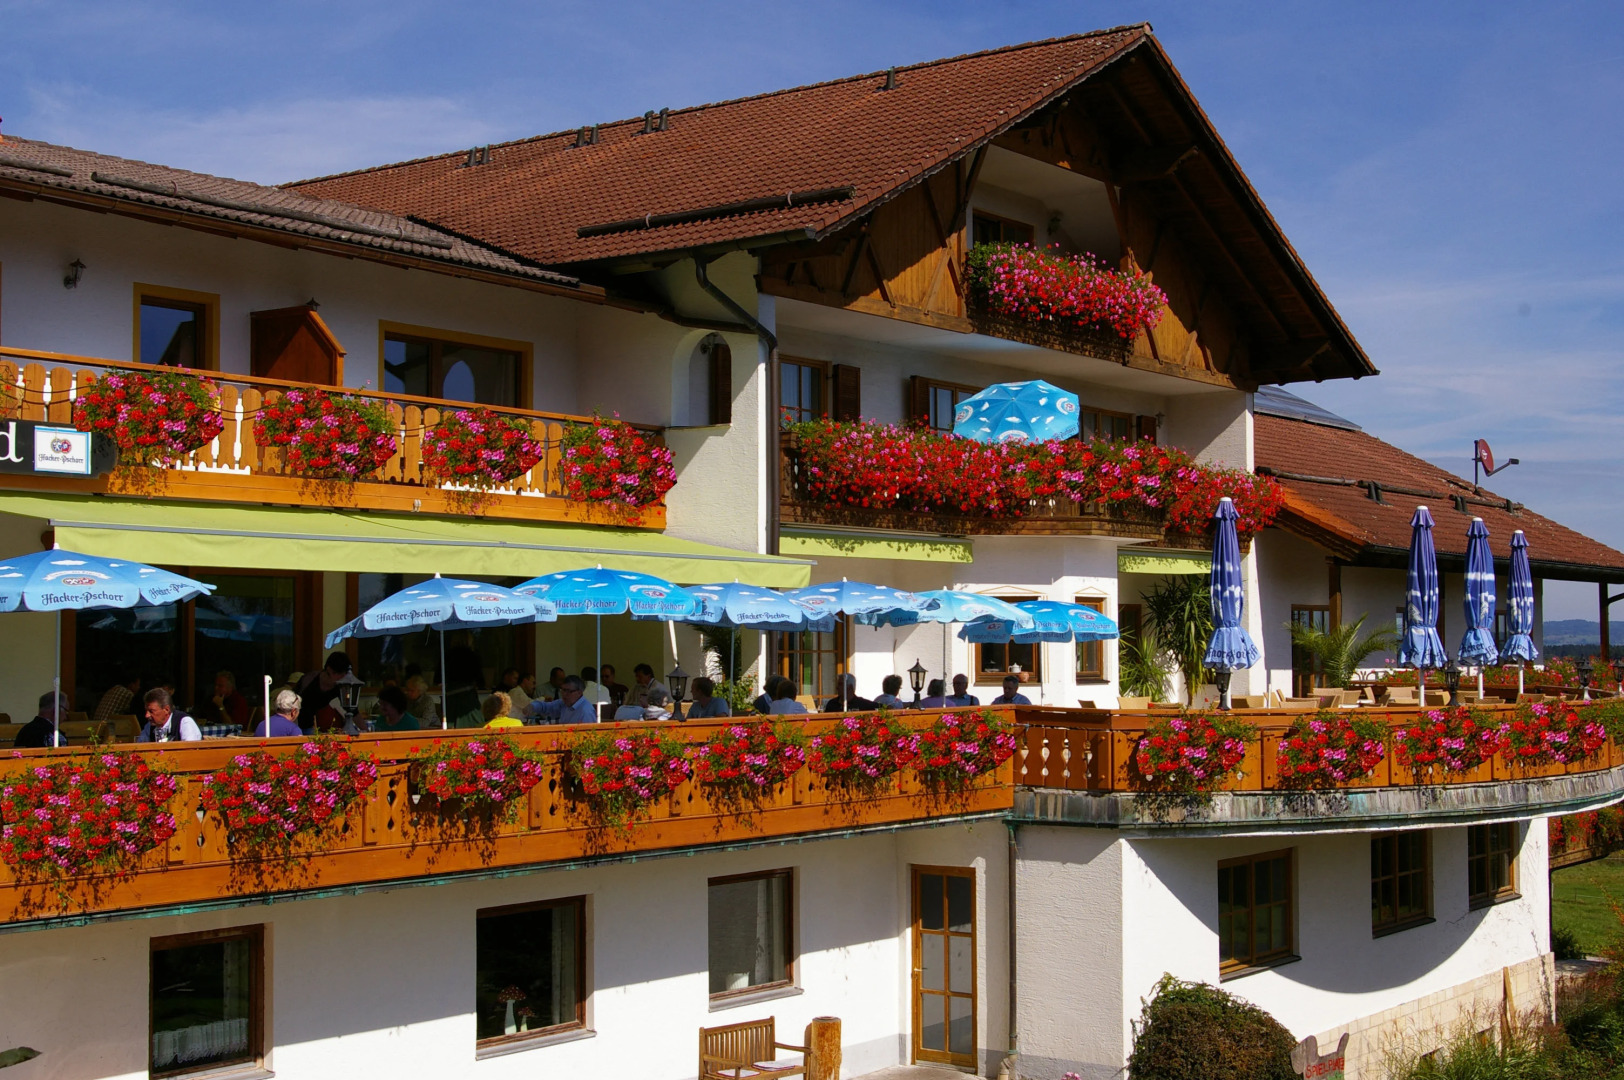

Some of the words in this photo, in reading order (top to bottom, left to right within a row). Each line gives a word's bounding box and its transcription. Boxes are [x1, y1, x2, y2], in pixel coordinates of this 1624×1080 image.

[39, 453, 84, 464] Hacker-Pschorr
[41, 591, 124, 606] Hacker-Pschorr
[465, 606, 525, 616] Hacker-Pschorr
[552, 599, 617, 612] Hacker-Pschorr
[635, 600, 685, 611] Hacker-Pschorr
[376, 608, 441, 624] Hacker-Pschorr
